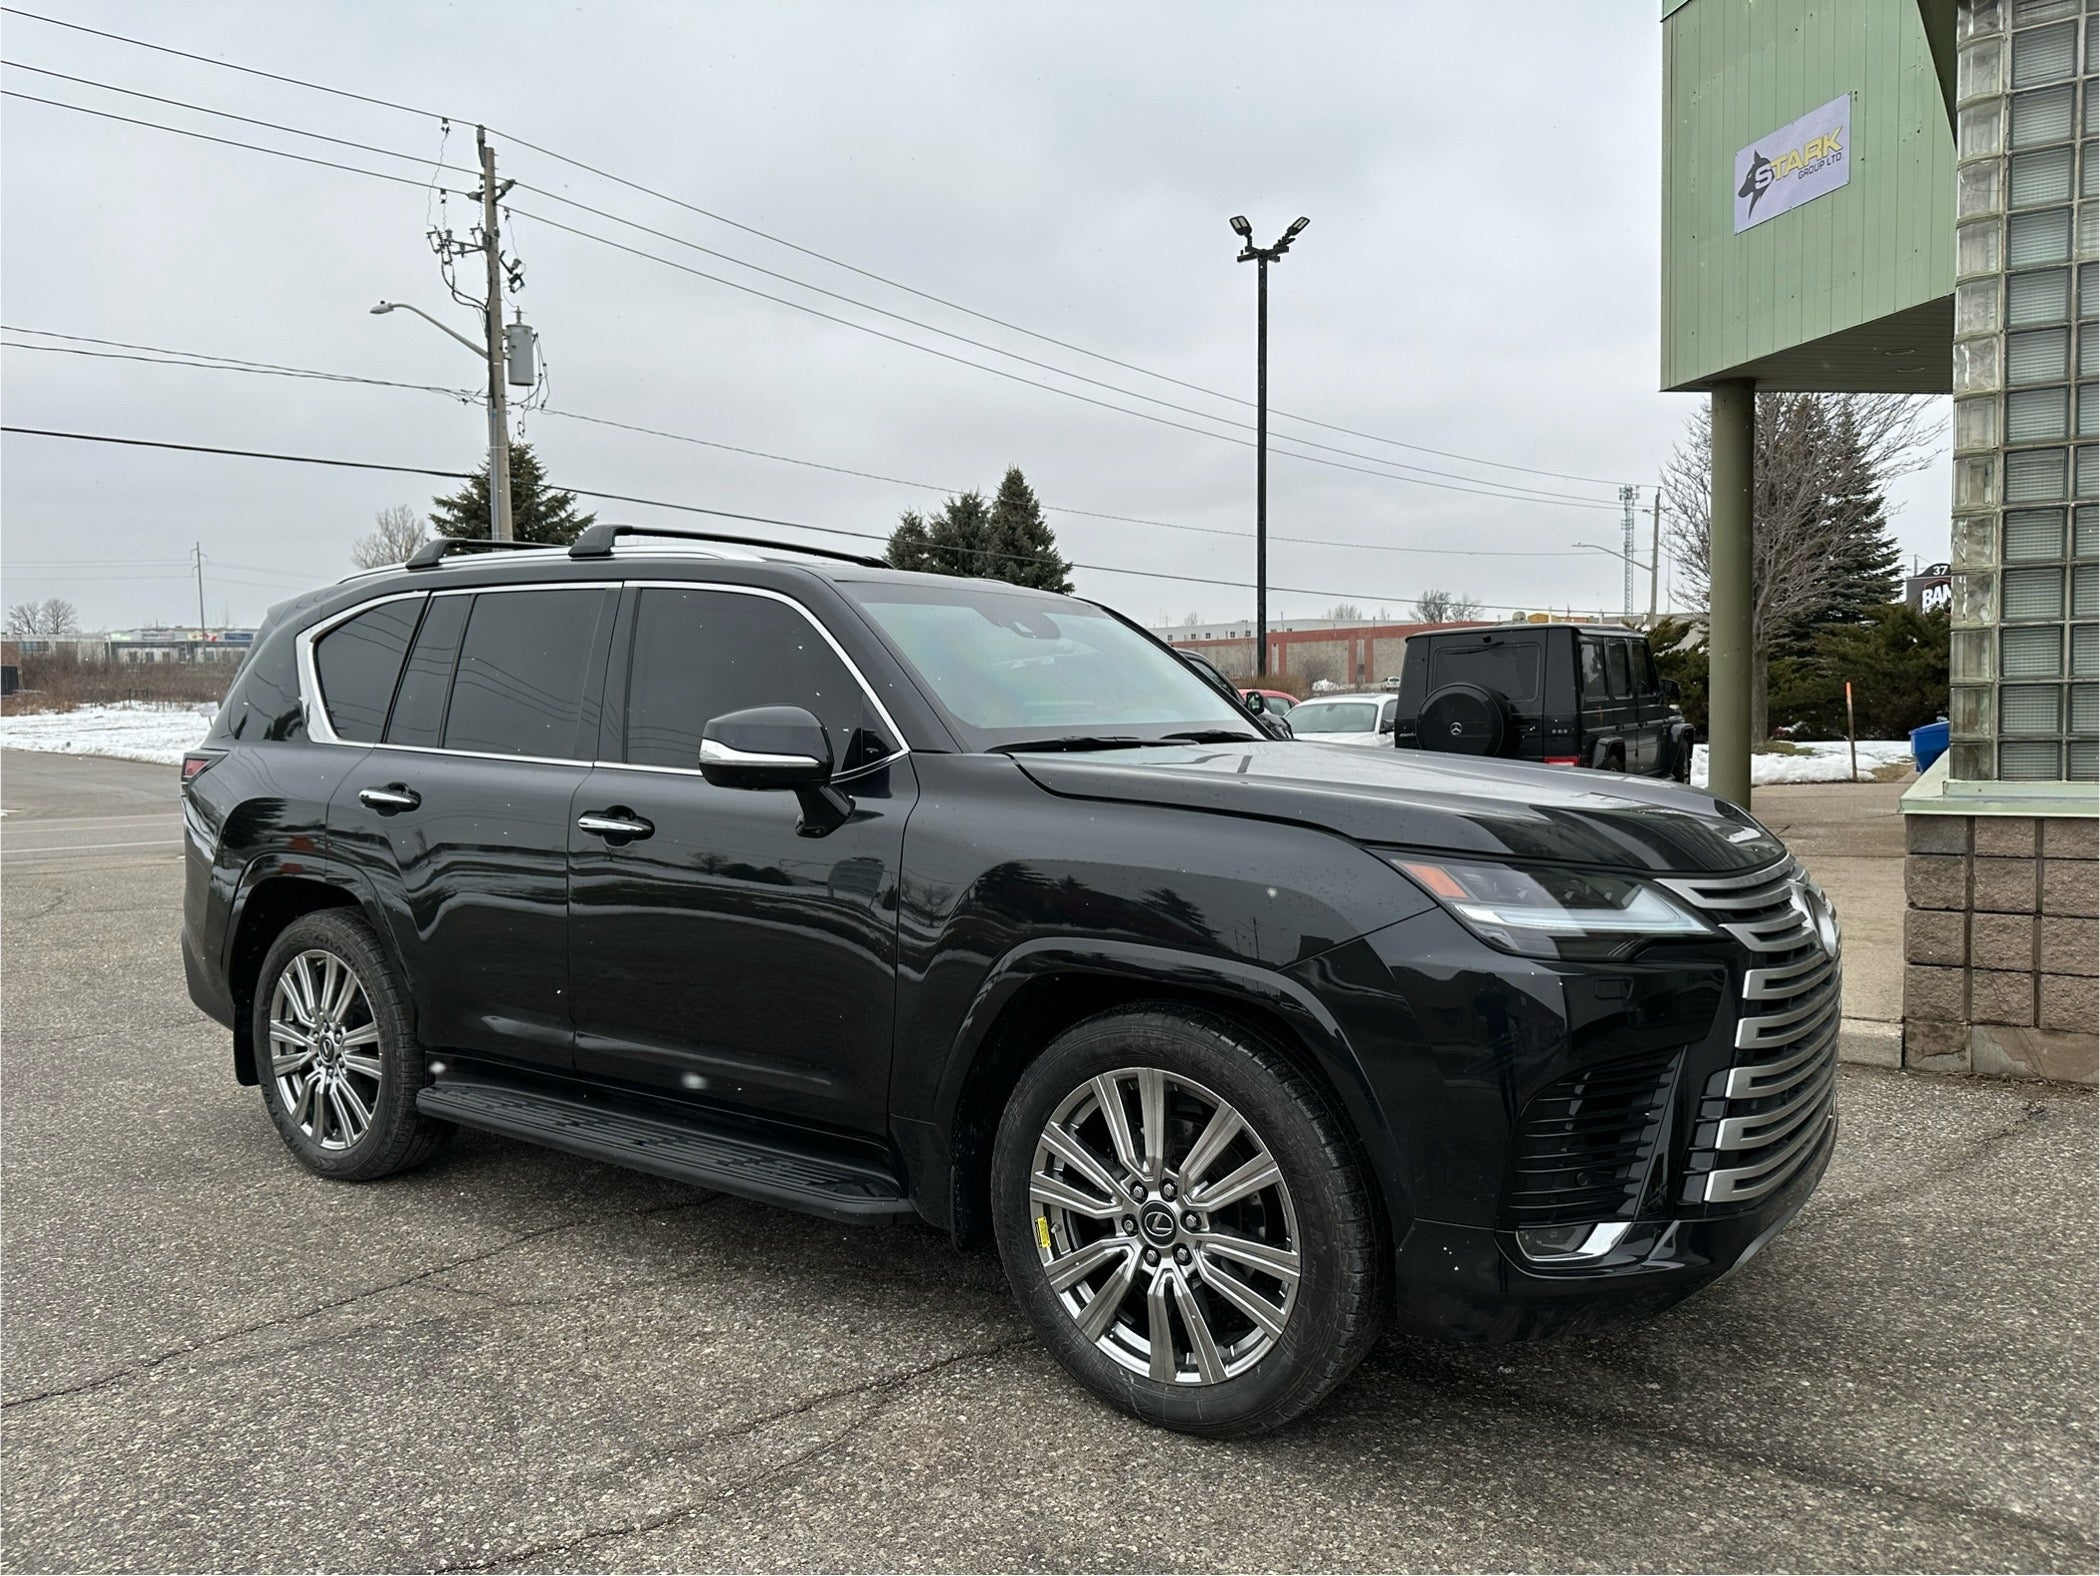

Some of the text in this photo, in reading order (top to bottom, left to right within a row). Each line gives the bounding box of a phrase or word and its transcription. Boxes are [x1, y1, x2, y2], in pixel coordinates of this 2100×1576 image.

[1755, 125, 1843, 189] STARK
[1797, 152, 1842, 180] GROUP LTD
